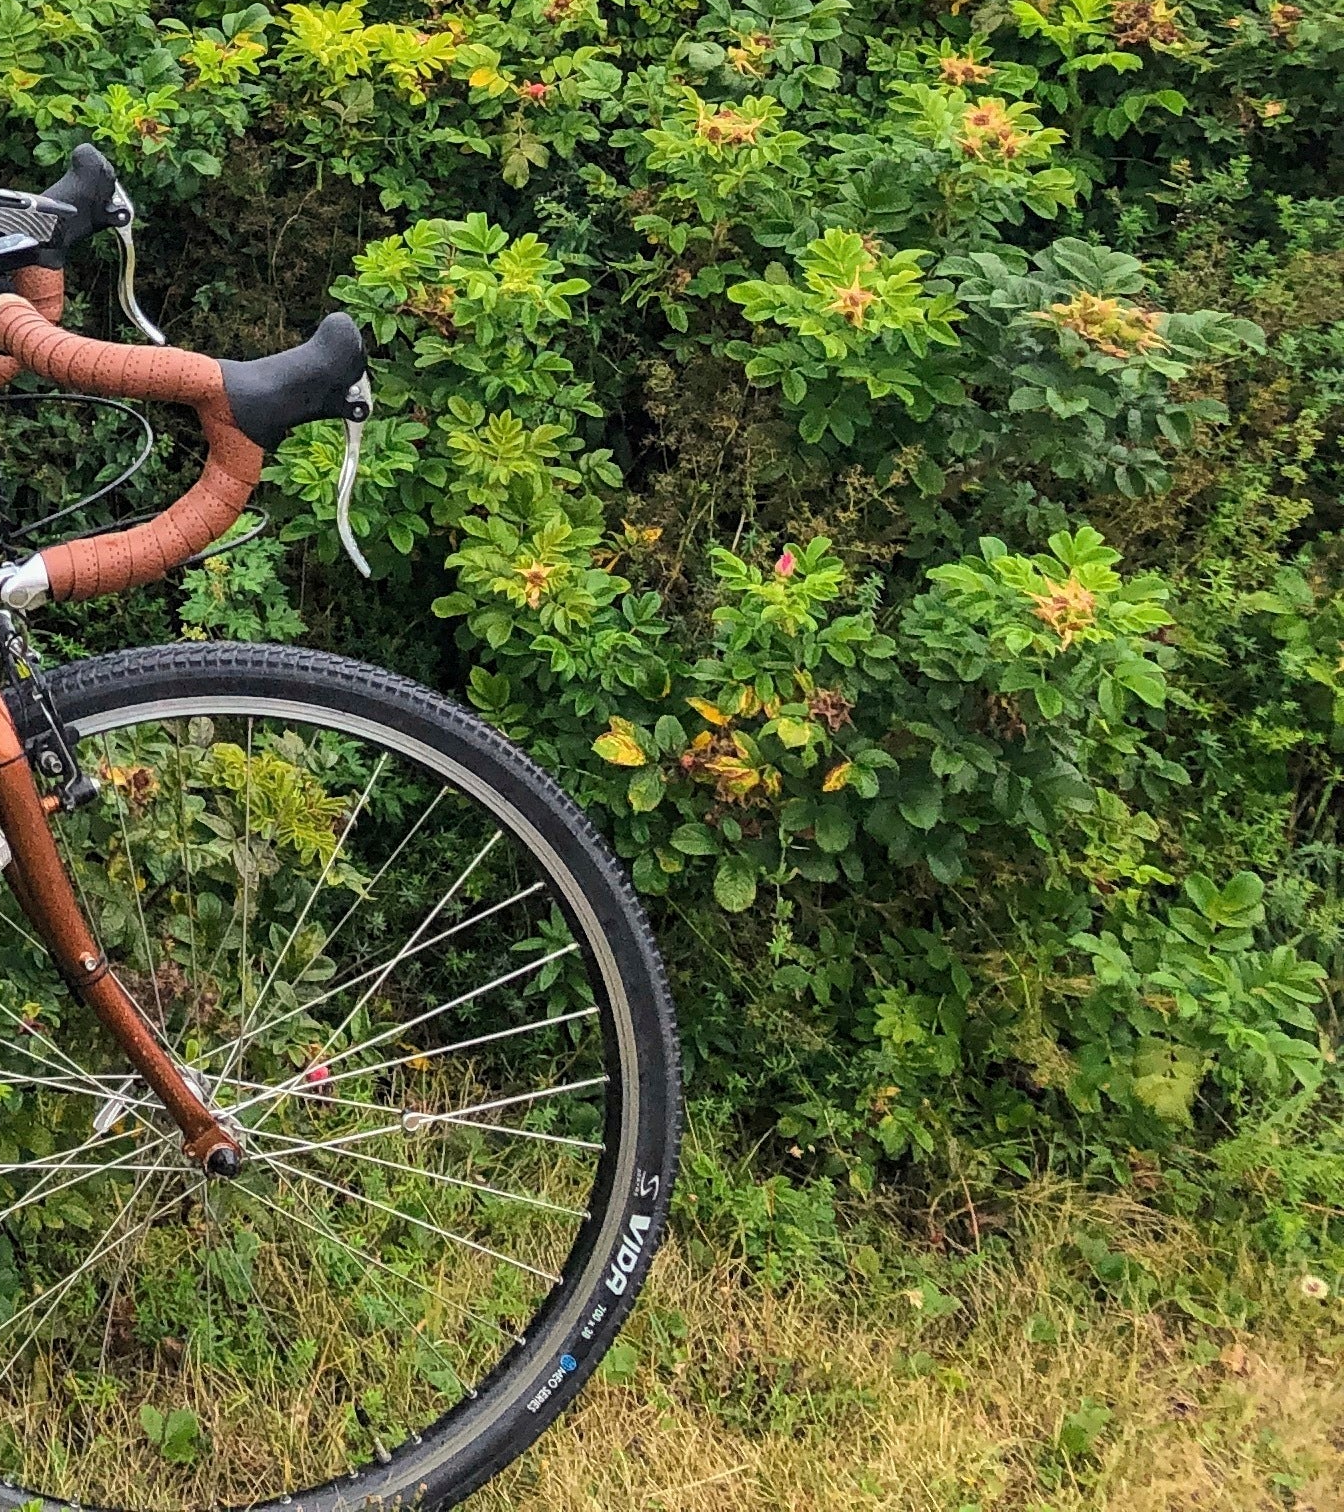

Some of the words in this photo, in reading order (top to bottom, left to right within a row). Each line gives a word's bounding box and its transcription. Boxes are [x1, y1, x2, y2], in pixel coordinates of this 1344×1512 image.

[605, 1214, 652, 1296] VIDA
[591, 1304, 607, 1323] 700
[547, 1366, 567, 1389] MEO
[526, 1386, 552, 1413] SERIES
